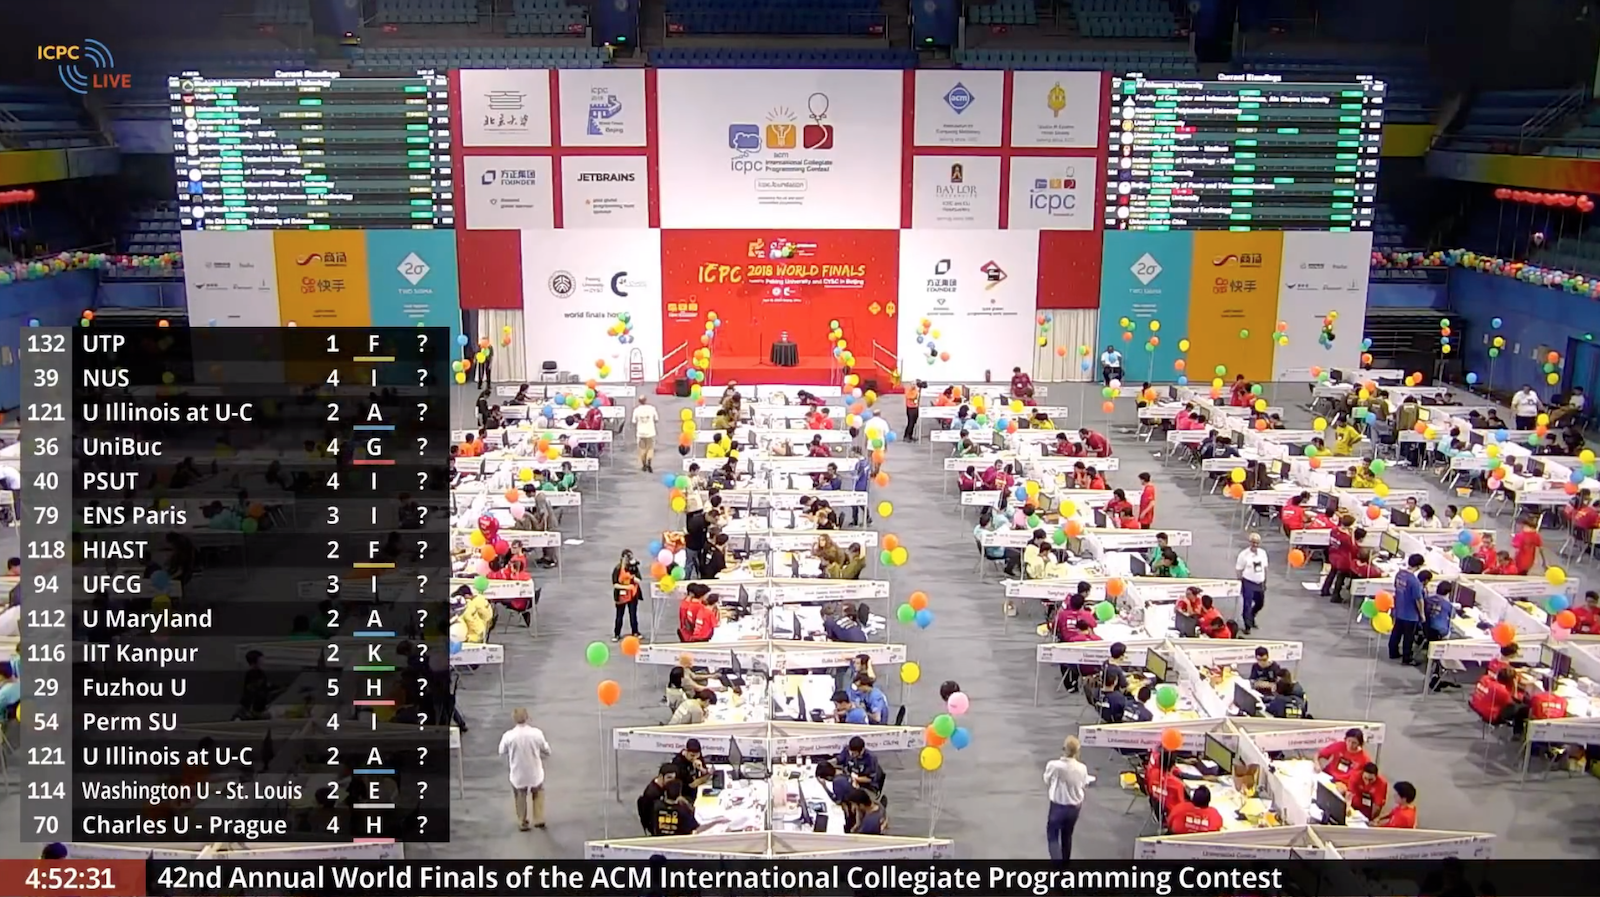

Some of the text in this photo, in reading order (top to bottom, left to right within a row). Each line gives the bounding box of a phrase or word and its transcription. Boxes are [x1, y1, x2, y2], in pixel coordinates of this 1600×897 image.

[275, 70, 303, 78] Current
[950, 94, 968, 102] acm
[731, 158, 763, 174] icpc
[803, 159, 833, 167] Collegiate
[577, 173, 635, 182] JETBRAINS
[936, 185, 977, 194] BAYLOR
[1030, 189, 1076, 215] icpc
[698, 264, 742, 283] ICPC
[747, 265, 773, 277] 2018
[776, 265, 819, 278] WORLD
[821, 265, 866, 277] FINALS
[317, 280, 346, 292] 快手
[1230, 280, 1257, 292] 快手
